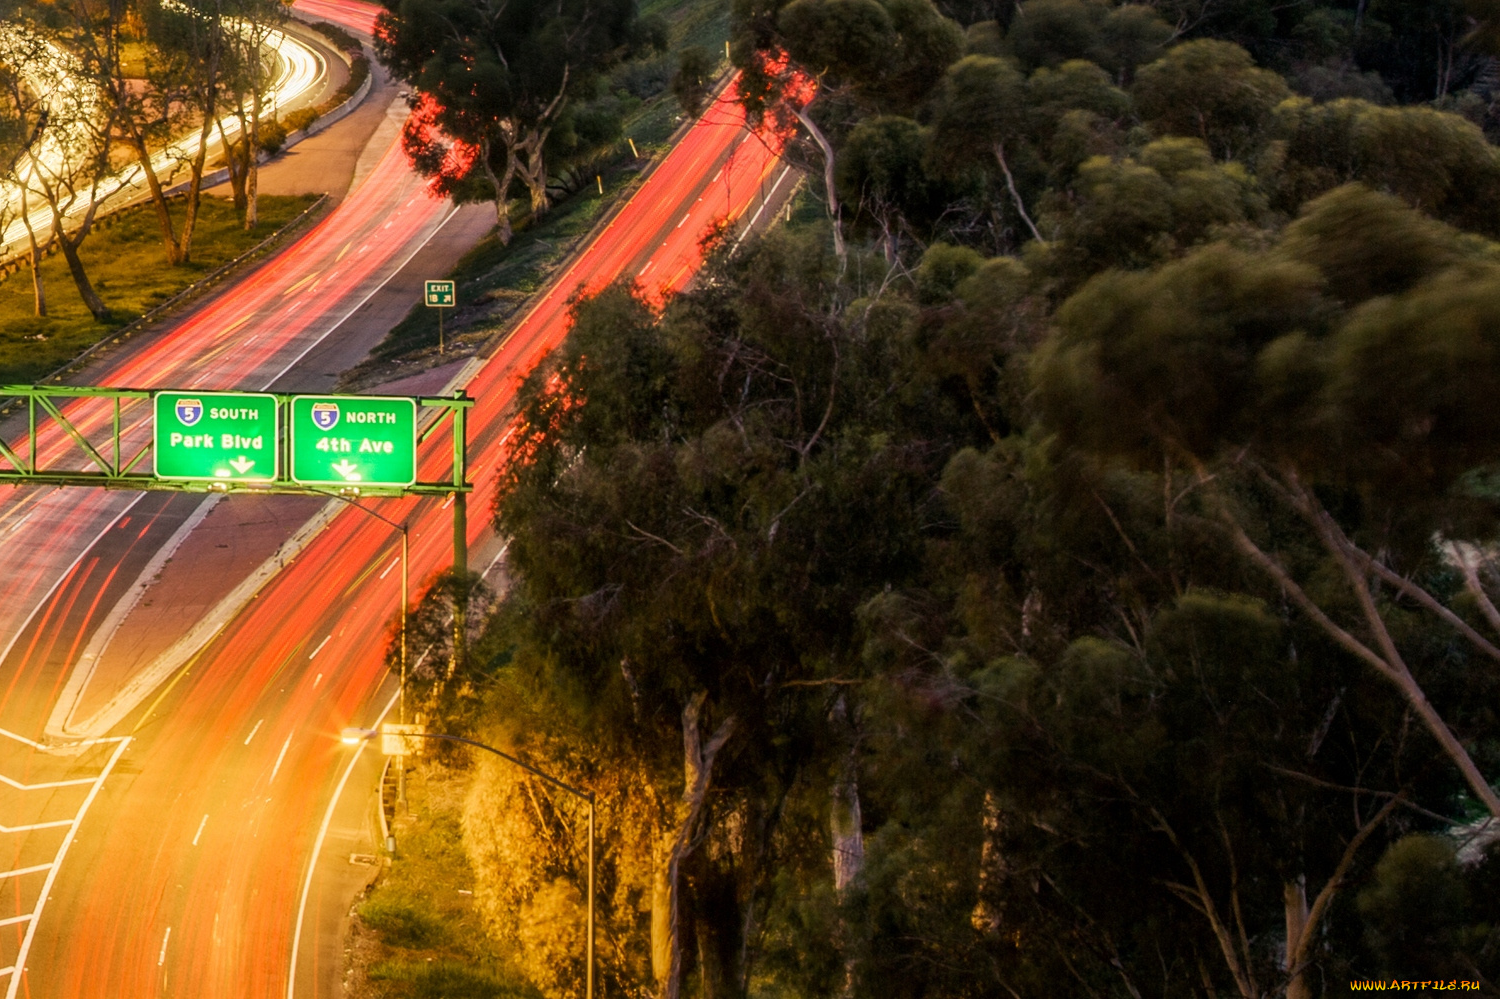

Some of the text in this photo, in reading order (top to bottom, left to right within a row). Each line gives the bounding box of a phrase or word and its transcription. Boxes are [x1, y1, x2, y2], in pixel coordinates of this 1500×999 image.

[430, 284, 449, 292] EXIT
[184, 407, 259, 421] 5 SOUTH
[320, 411, 396, 426] 5 NORTH
[170, 432, 263, 450] Park Blvd
[315, 437, 394, 454] 4th Ave
